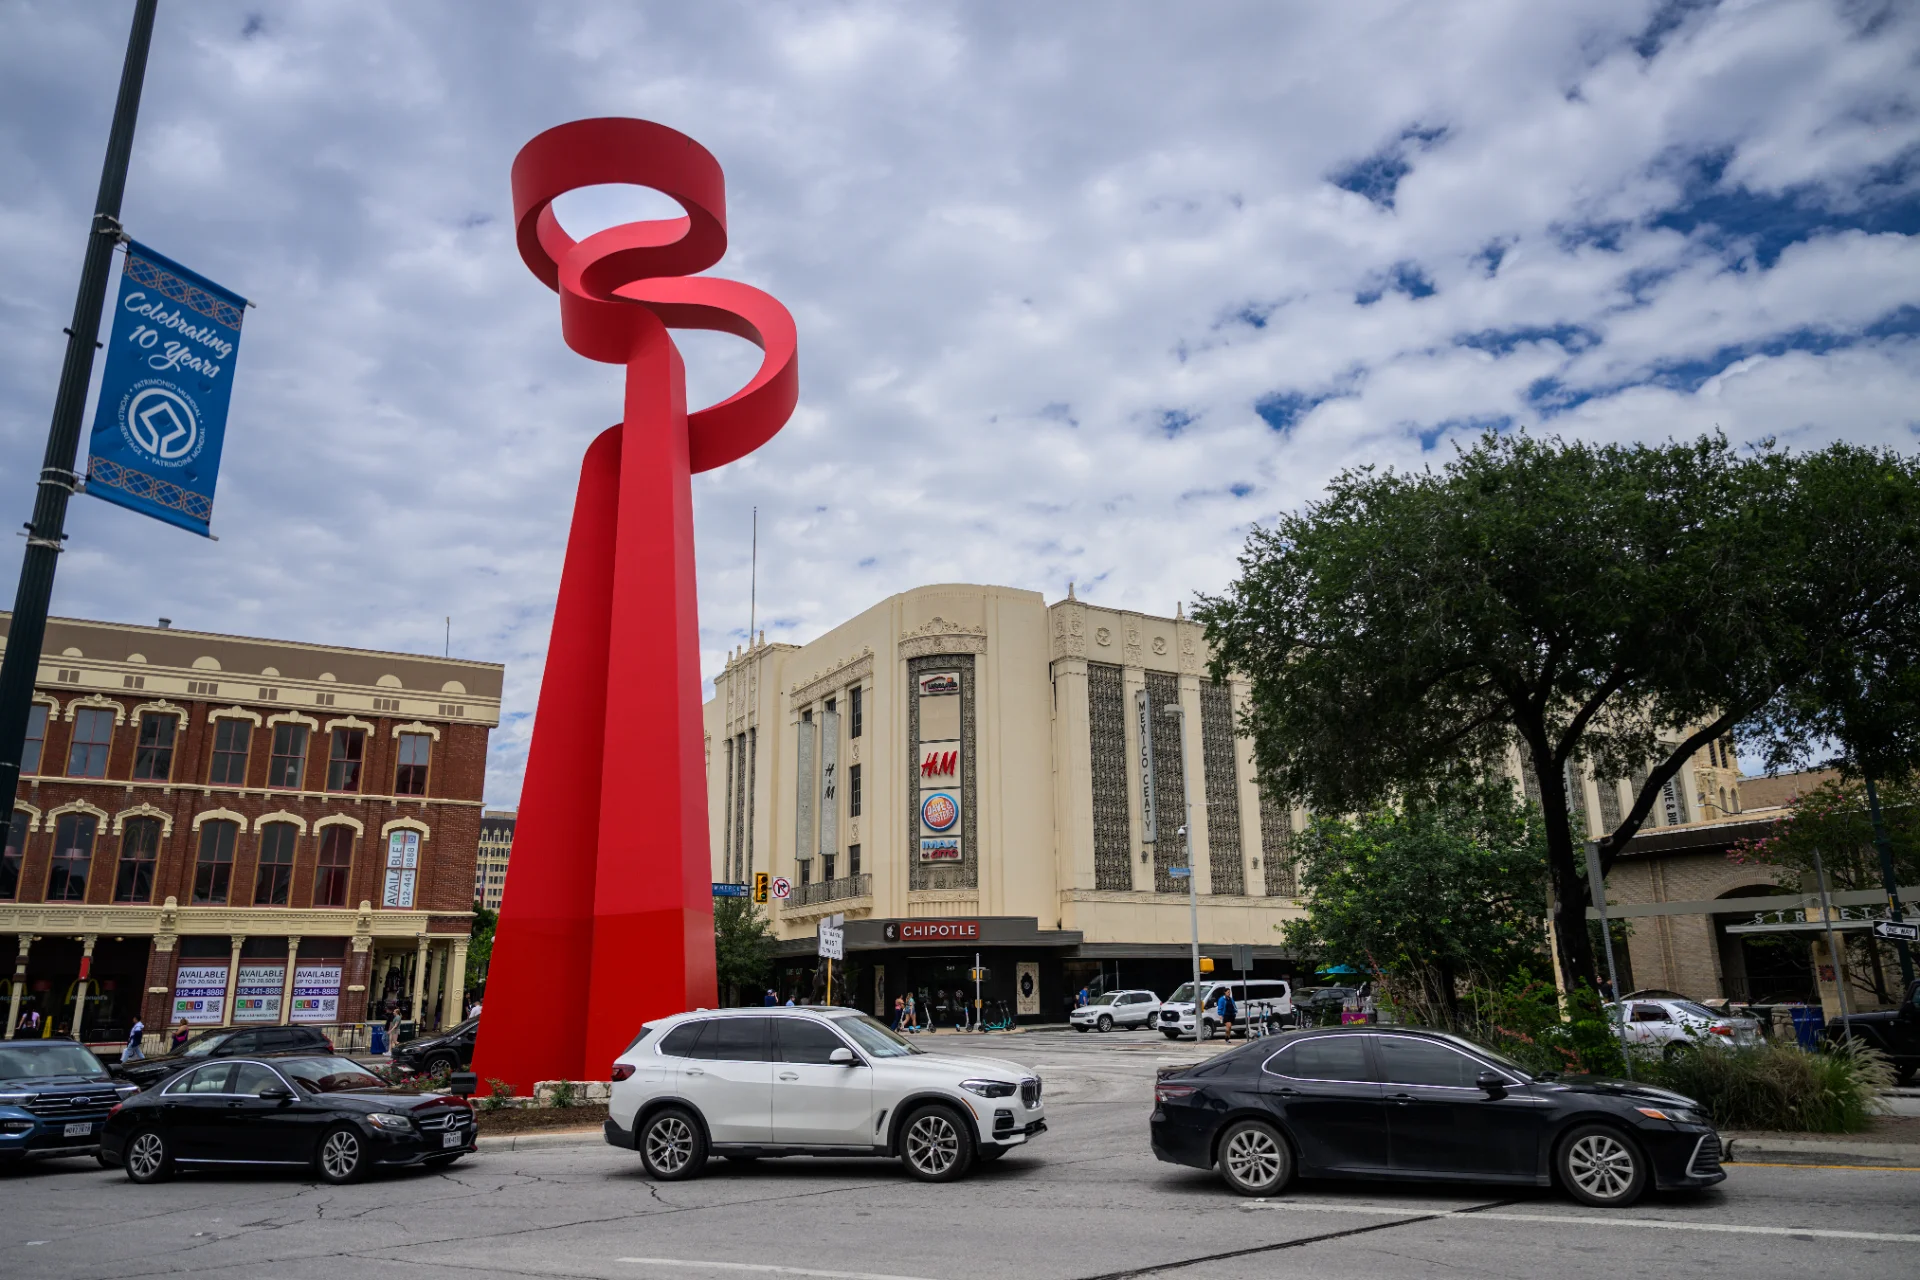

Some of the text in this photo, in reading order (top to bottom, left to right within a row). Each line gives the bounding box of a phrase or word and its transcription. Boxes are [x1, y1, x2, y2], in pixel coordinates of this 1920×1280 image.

[124, 292, 233, 359] Celebrating
[128, 325, 221, 379] 10 Years
[133, 379, 202, 418] PATRIMONIO MUNDIAL
[118, 394, 143, 456] WORLD HERITAGE
[152, 427, 206, 468] PATRIMOINE MONDIAL
[921, 751, 958, 778] H&M
[1138, 701, 1152, 832] MEXICO CEATY
[927, 802, 947, 815] DAVE
[922, 840, 958, 849] IMAX
[387, 847, 402, 905] AVAILABLE
[402, 847, 415, 906] 512-441-8888
[713, 884, 740, 892] MMERCE
[903, 925, 976, 936] CHIPOTLE
[1886, 926, 1898, 934] ONE
